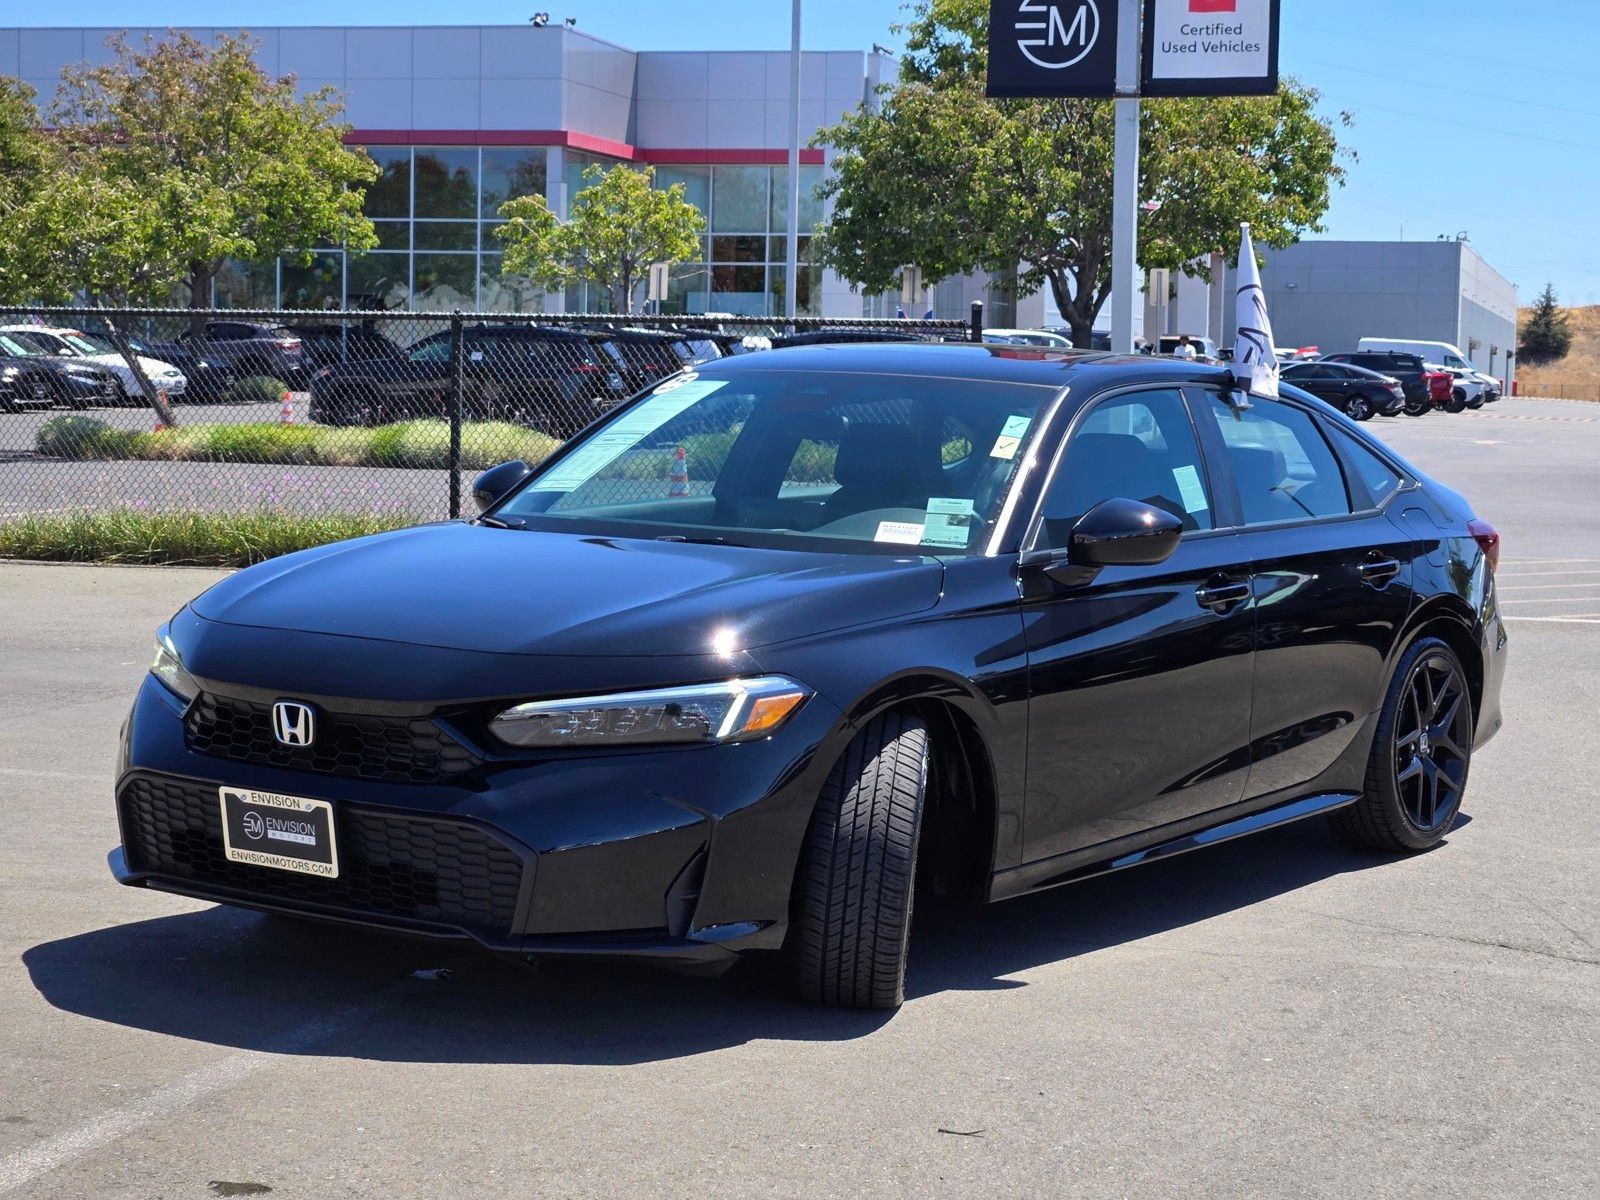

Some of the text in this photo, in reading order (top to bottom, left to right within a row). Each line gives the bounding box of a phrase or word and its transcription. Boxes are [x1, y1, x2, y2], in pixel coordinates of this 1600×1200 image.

[1179, 23, 1243, 36] Certified
[1161, 40, 1261, 54] Used Vehicles
[251, 792, 301, 809] ENVISION
[265, 817, 316, 836] ENVISION
[231, 850, 333, 875] ENVISIONMOTORS.COM
